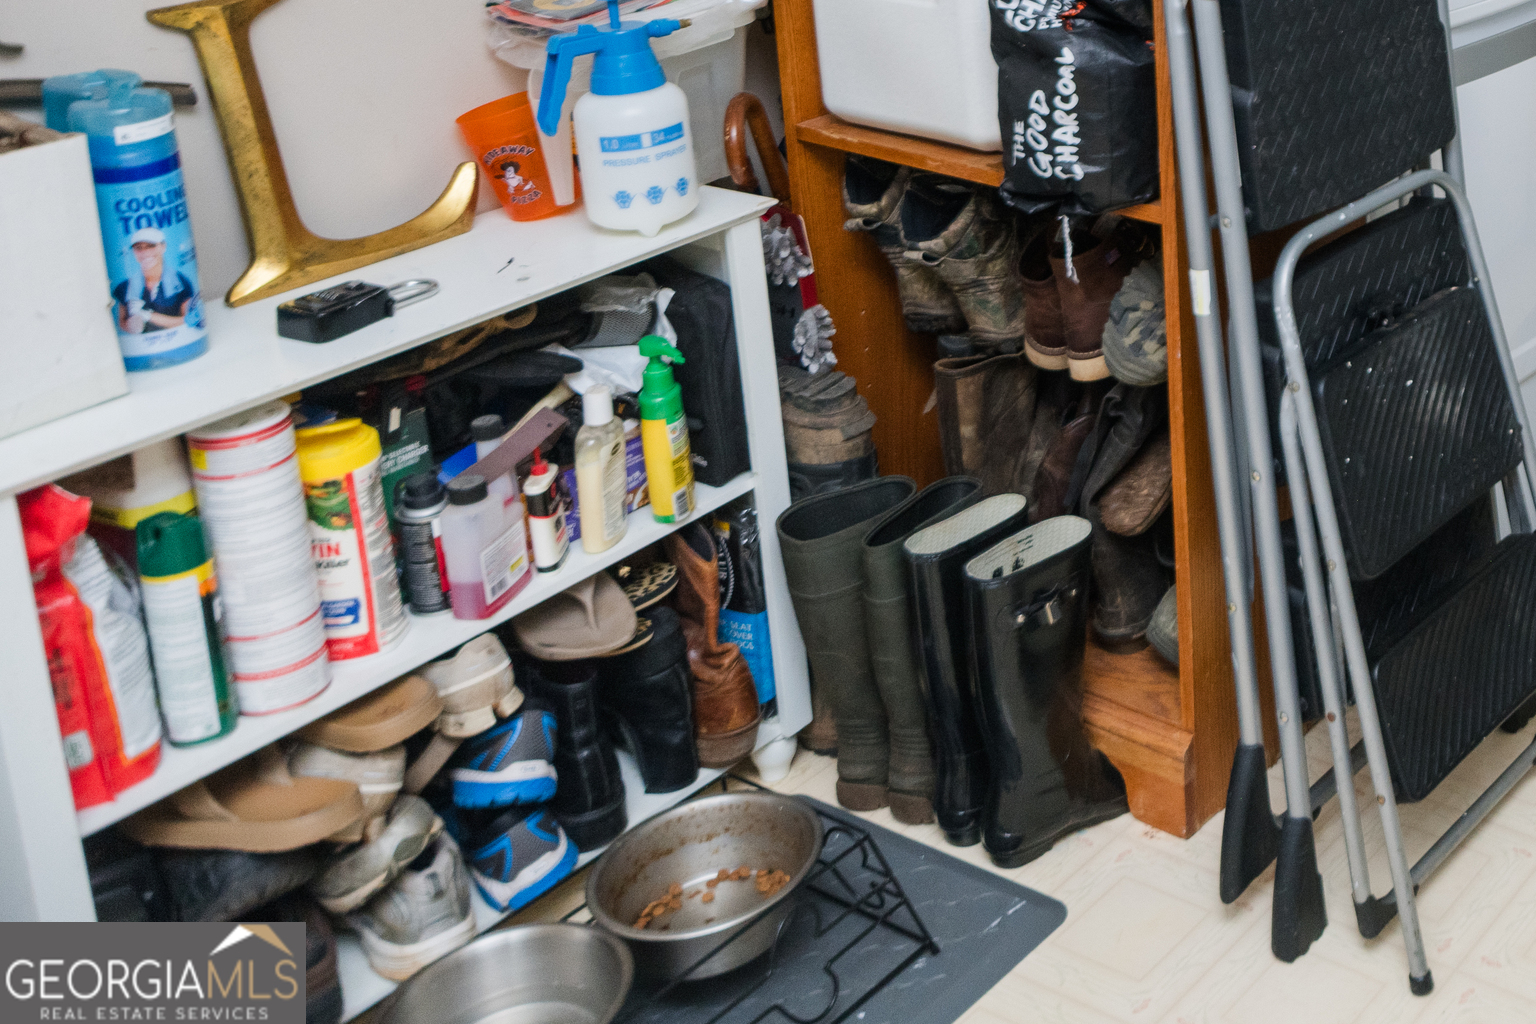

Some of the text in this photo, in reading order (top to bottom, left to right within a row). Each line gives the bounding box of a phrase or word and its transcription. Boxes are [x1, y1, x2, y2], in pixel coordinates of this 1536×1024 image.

[1052, 46, 1085, 182] CHARCOAL
[603, 139, 619, 150] 1.0
[652, 131, 665, 143] 34
[1012, 119, 1026, 167] THE
[1025, 89, 1053, 179] GOOD
[483, 144, 536, 166] HIDEAWAY
[602, 143, 687, 167] PRESSURE SPRAYER
[114, 183, 186, 214] COOLIN
[510, 189, 543, 205] PIZZA
[118, 201, 189, 236] TOWE
